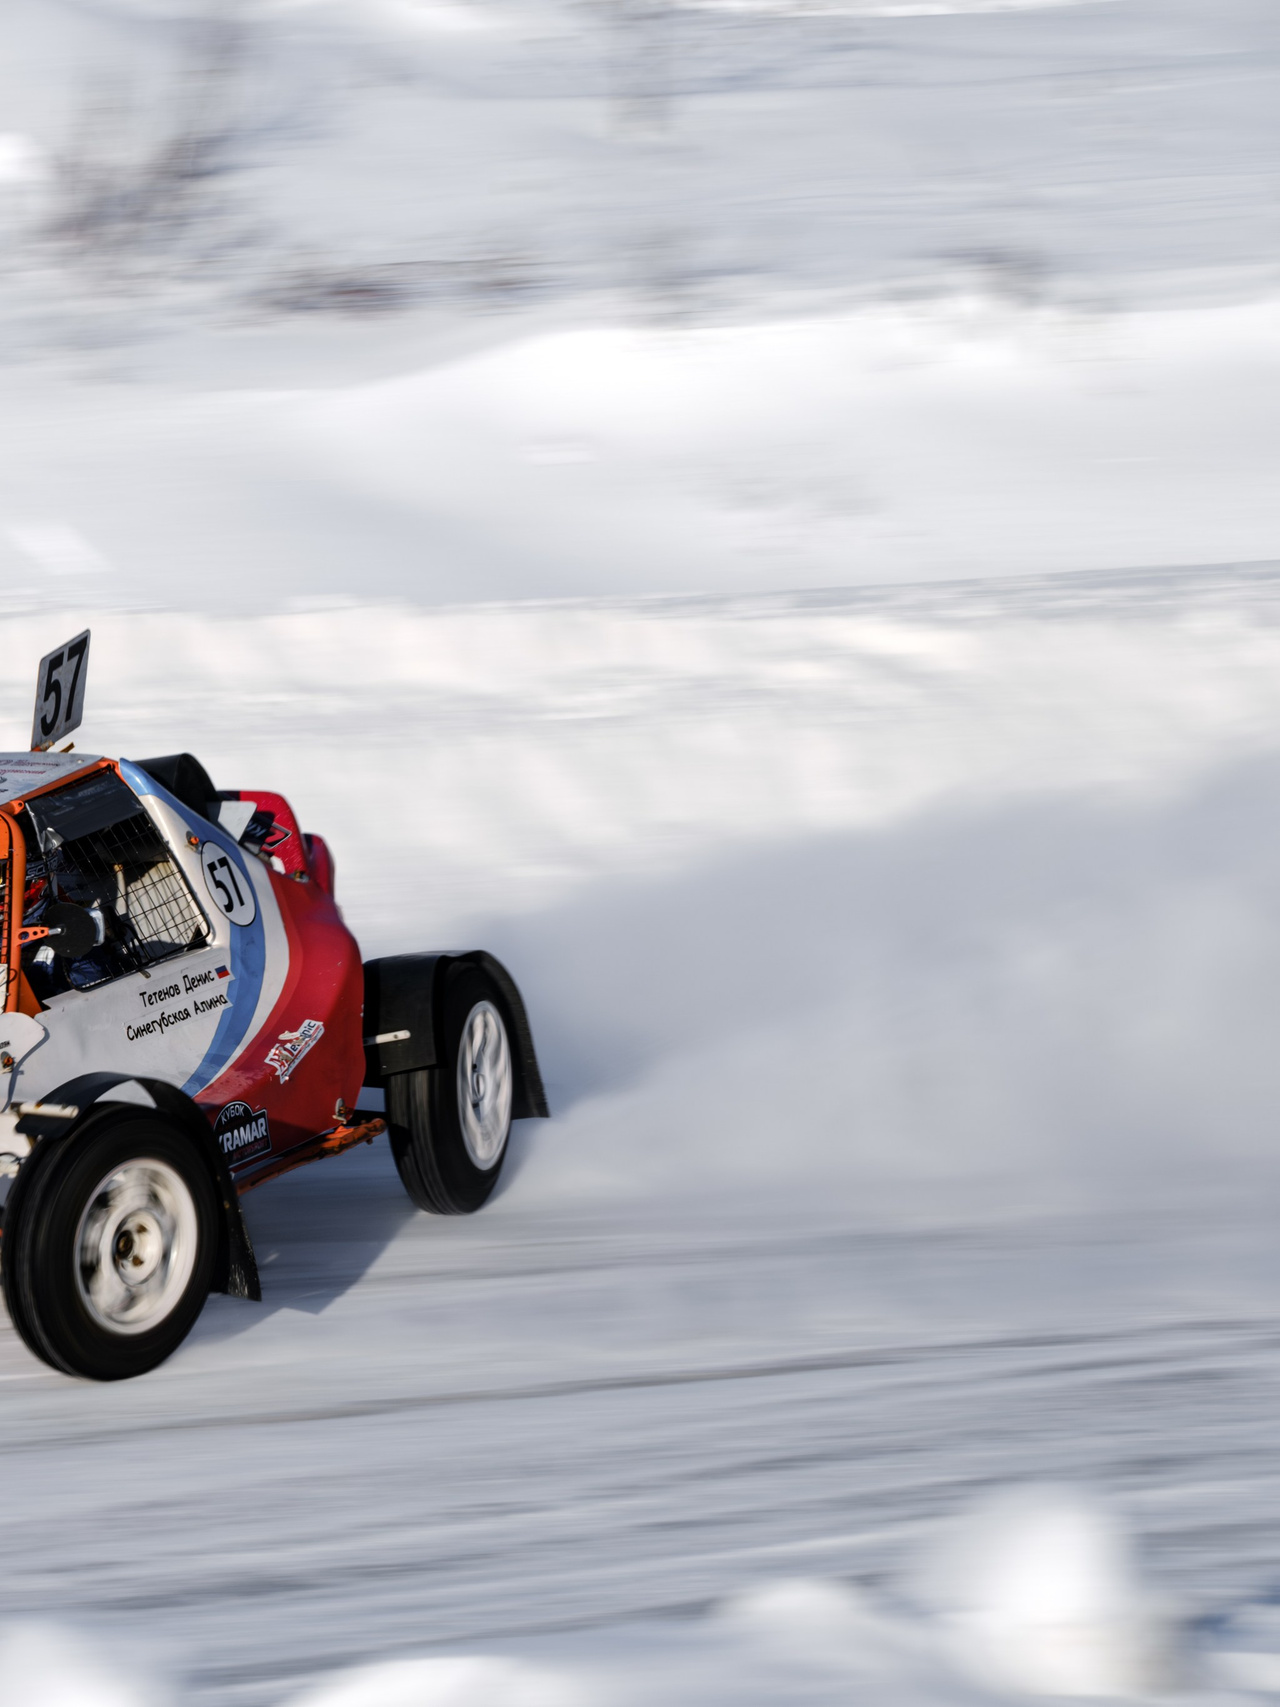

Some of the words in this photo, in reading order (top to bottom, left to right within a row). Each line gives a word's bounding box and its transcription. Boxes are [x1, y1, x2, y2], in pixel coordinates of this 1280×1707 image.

[40, 636, 88, 737] 57
[207, 856, 245, 913] 57
[139, 984, 180, 1008] Тетенов
[182, 970, 215, 995] Денис
[126, 1008, 191, 1041] Синегубская
[193, 994, 228, 1015] Алина
[221, 1104, 245, 1125] КУБОК
